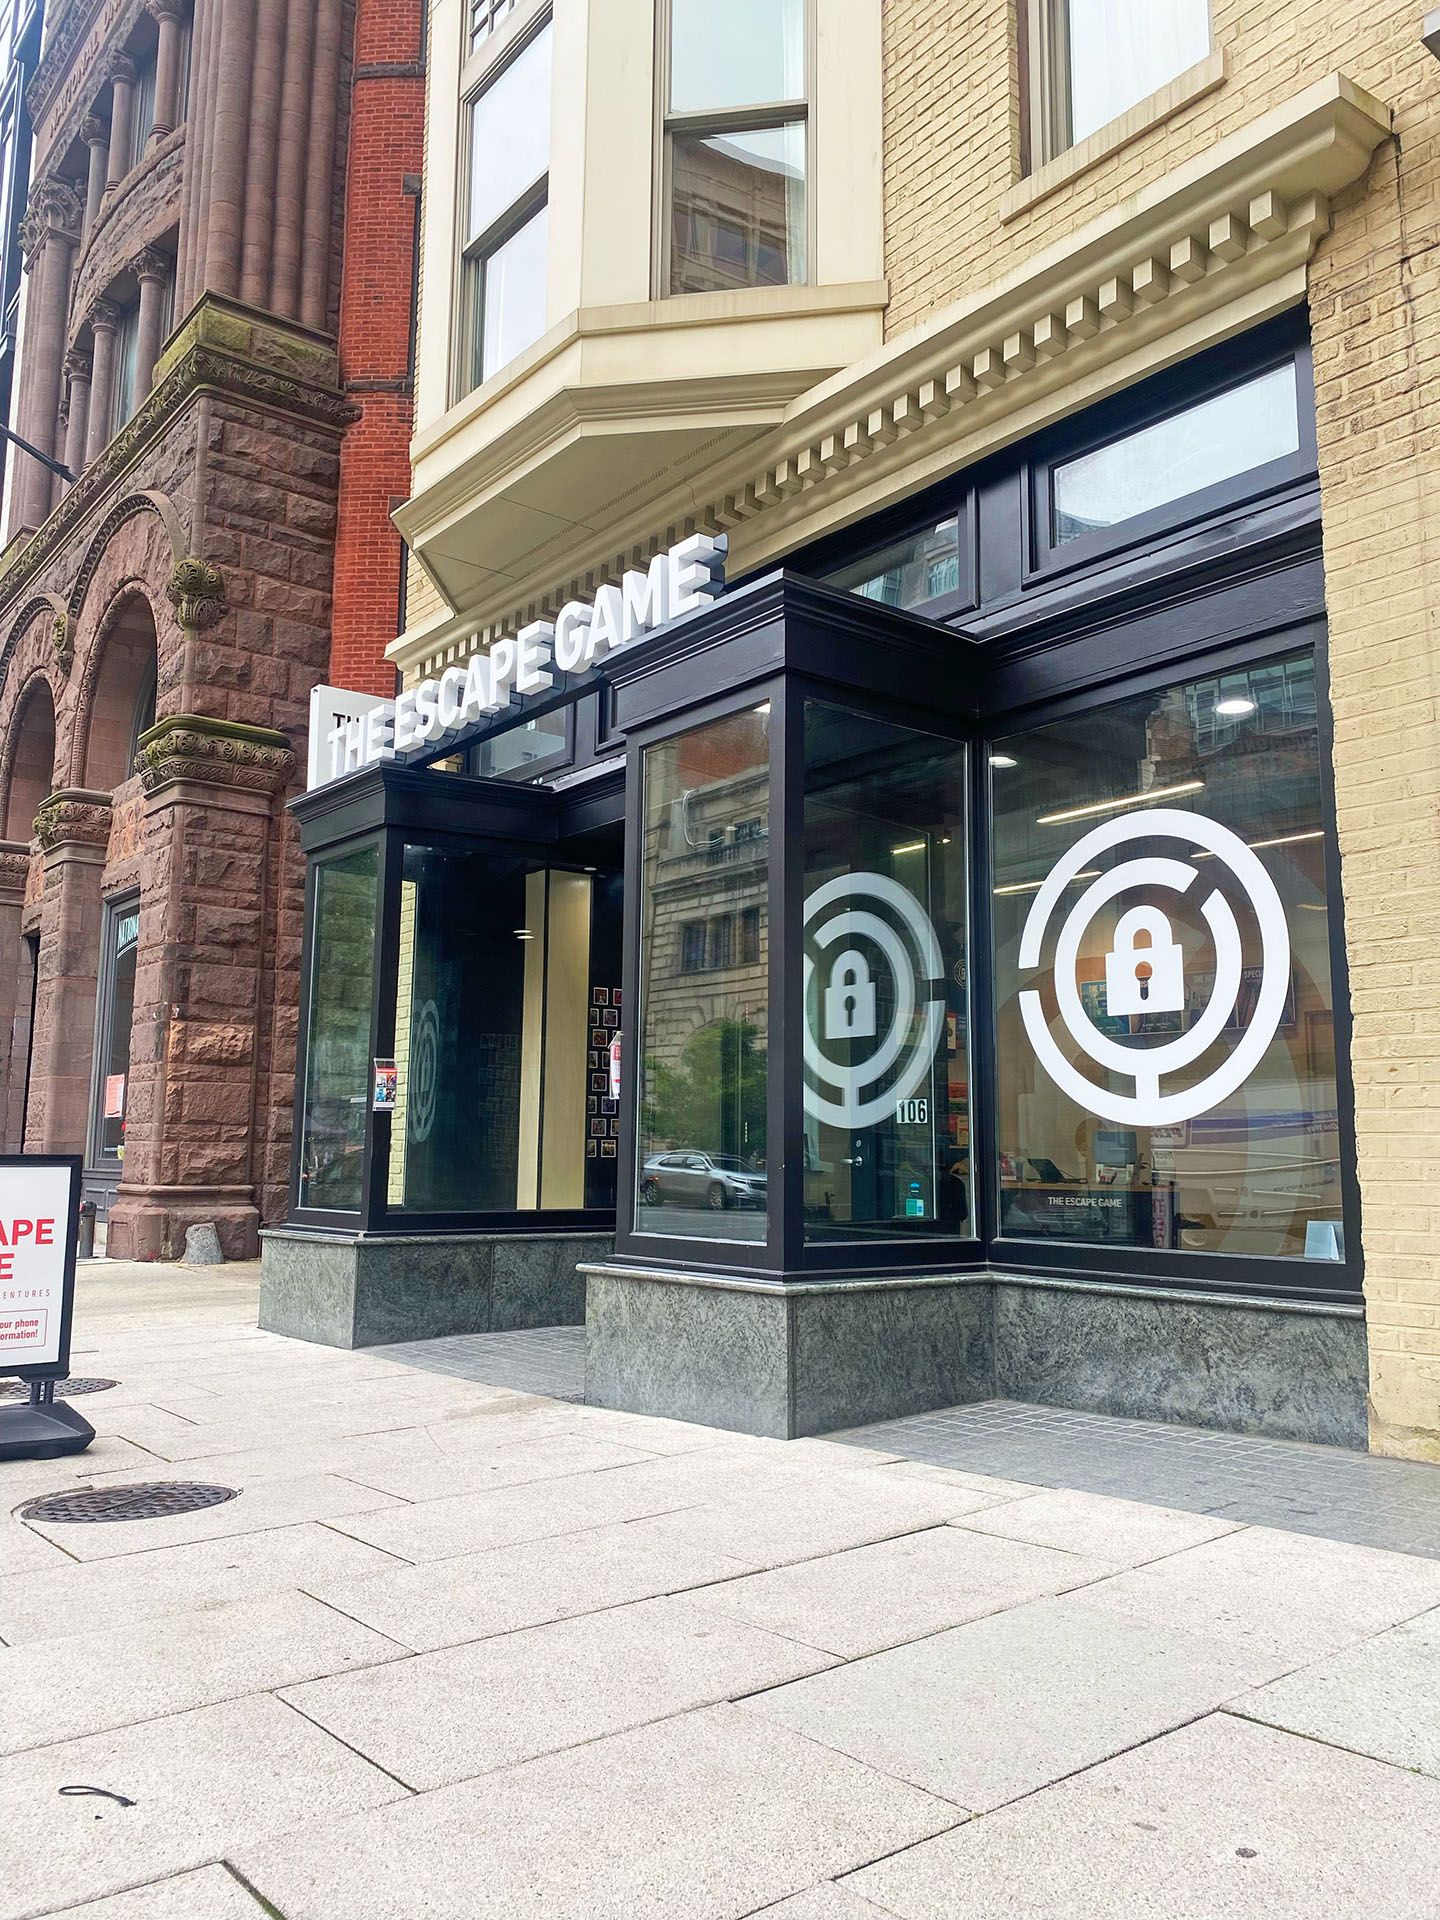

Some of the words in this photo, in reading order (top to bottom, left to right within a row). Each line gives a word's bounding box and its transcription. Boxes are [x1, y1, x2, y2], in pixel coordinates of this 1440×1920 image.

[327, 704, 395, 780] THE
[395, 620, 554, 754] ESCAPE
[555, 533, 714, 673] GAME
[898, 1100, 926, 1122] 106
[1048, 1196, 1064, 1206] THE
[1065, 1197, 1097, 1207] ESCAPE
[1098, 1199, 1122, 1208] GAME
[15, 1318, 39, 1330] phone
[0, 1329, 38, 1341] ormation!
